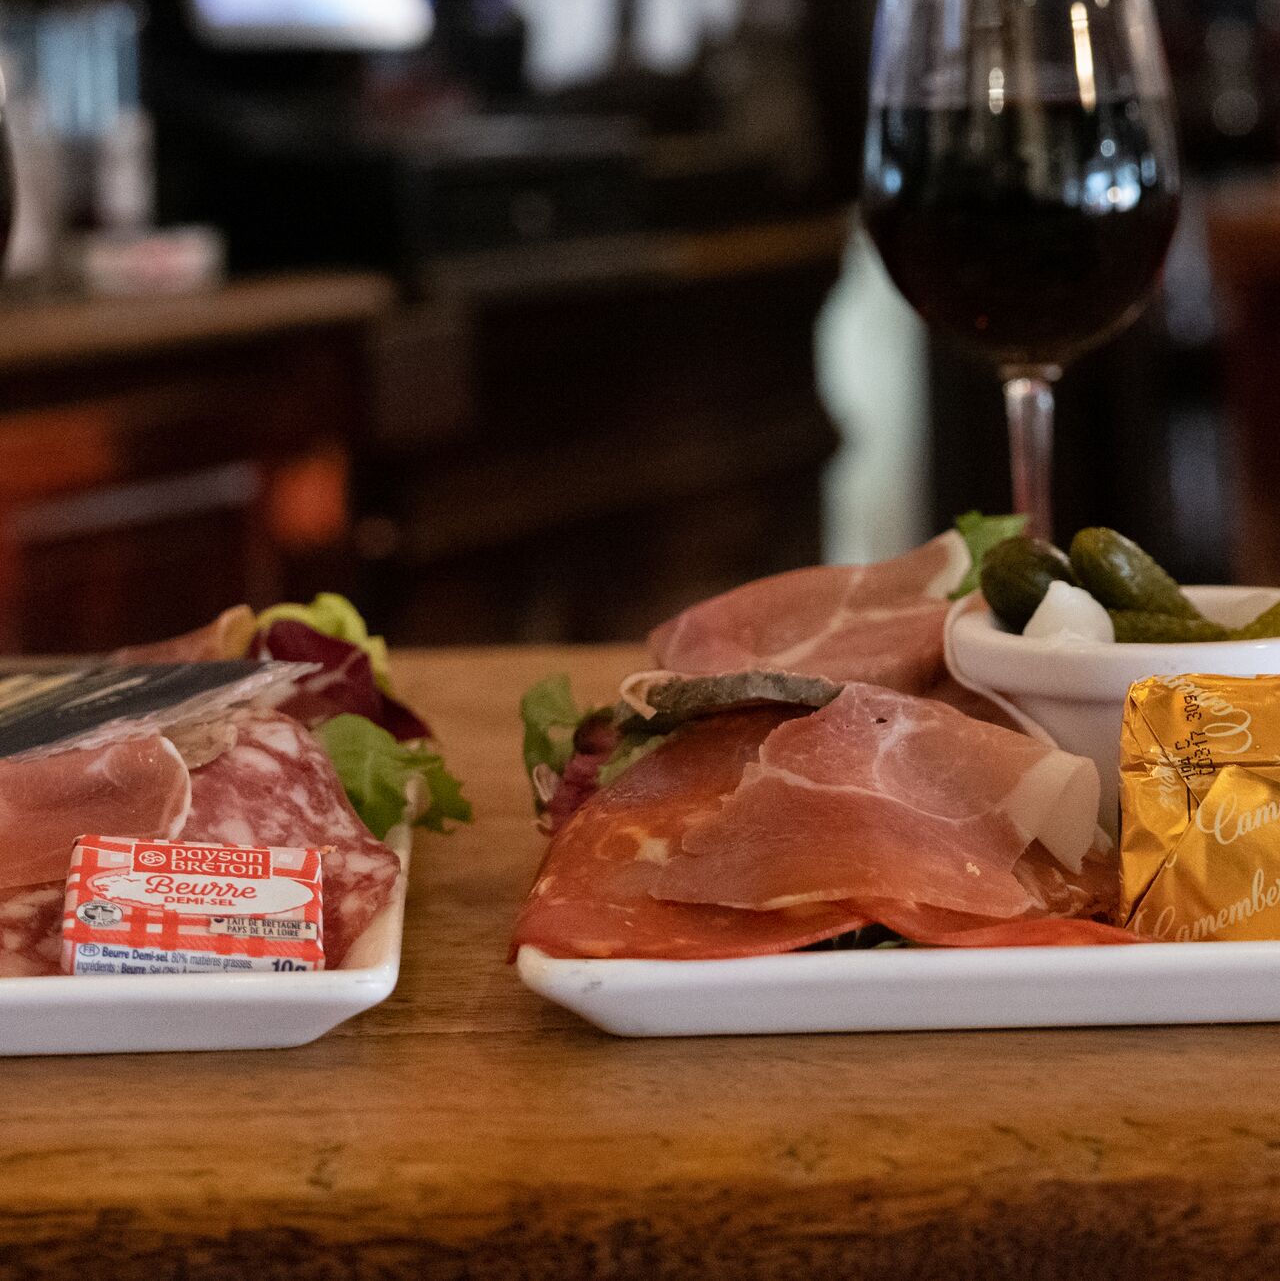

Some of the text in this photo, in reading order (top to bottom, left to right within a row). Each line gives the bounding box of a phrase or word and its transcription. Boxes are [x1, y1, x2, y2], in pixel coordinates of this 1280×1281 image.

[145, 875, 257, 899] Beurre
[164, 896, 237, 907] DEMI-SEL
[227, 918, 244, 926] LAIT
[249, 918, 257, 927] DE
[262, 919, 301, 930] BRETAGNE
[227, 925, 299, 937] PAYS DE LA LOIRE
[102, 946, 130, 959] Beurre
